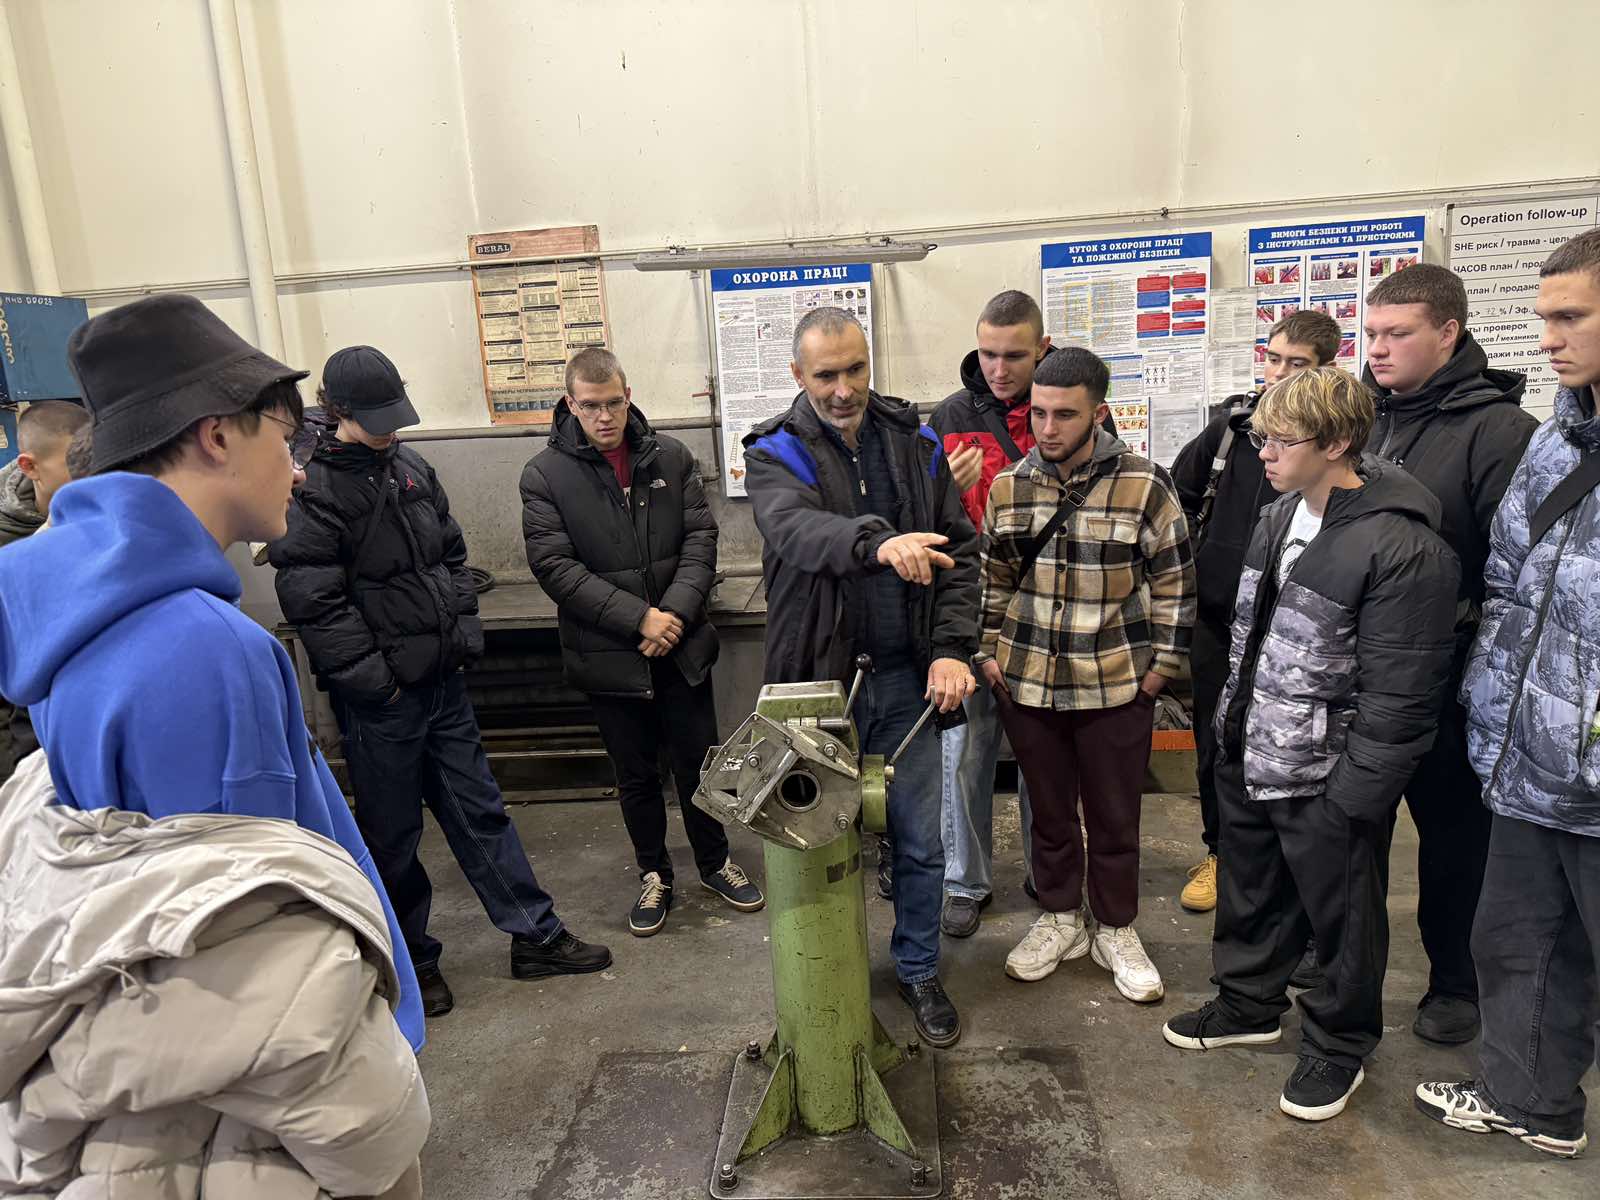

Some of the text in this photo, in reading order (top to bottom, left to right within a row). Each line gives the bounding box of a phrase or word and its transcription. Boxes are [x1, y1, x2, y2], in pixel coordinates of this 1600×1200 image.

[1460, 207, 1587, 227] Operation follow-up
[1271, 222, 1402, 239] ВИМОГИ БЕЗПЕКИ ПРИ РОБОТІ
[1069, 245, 1098, 254] КУТОК
[1109, 241, 1152, 251] ОХОРОНИ
[1155, 238, 1183, 248] ПРАЦІ
[1266, 237, 1339, 249] ІНСТРУМЕНТАМИ
[1341, 235, 1353, 243] ТА
[1356, 231, 1415, 242] ПРИСТРОЯМИ
[1454, 242, 1474, 251] SHE
[1476, 242, 1498, 252] риск
[1507, 238, 1540, 248] травма
[477, 244, 510, 254] BERAL
[1072, 248, 1181, 264] ТА ПОЖЕЖНОЇ БЕЗПЕКИ
[1454, 264, 1487, 273] ЧАСОВ
[1490, 263, 1512, 271] план
[732, 266, 848, 285] ОХОРОНА ПРАЦІ
[1467, 287, 1490, 295] план
[1500, 284, 1540, 293] продано
[1483, 322, 1528, 333] проверок
[1501, 334, 1539, 342] механиков
[1487, 351, 1511, 359] дажи
